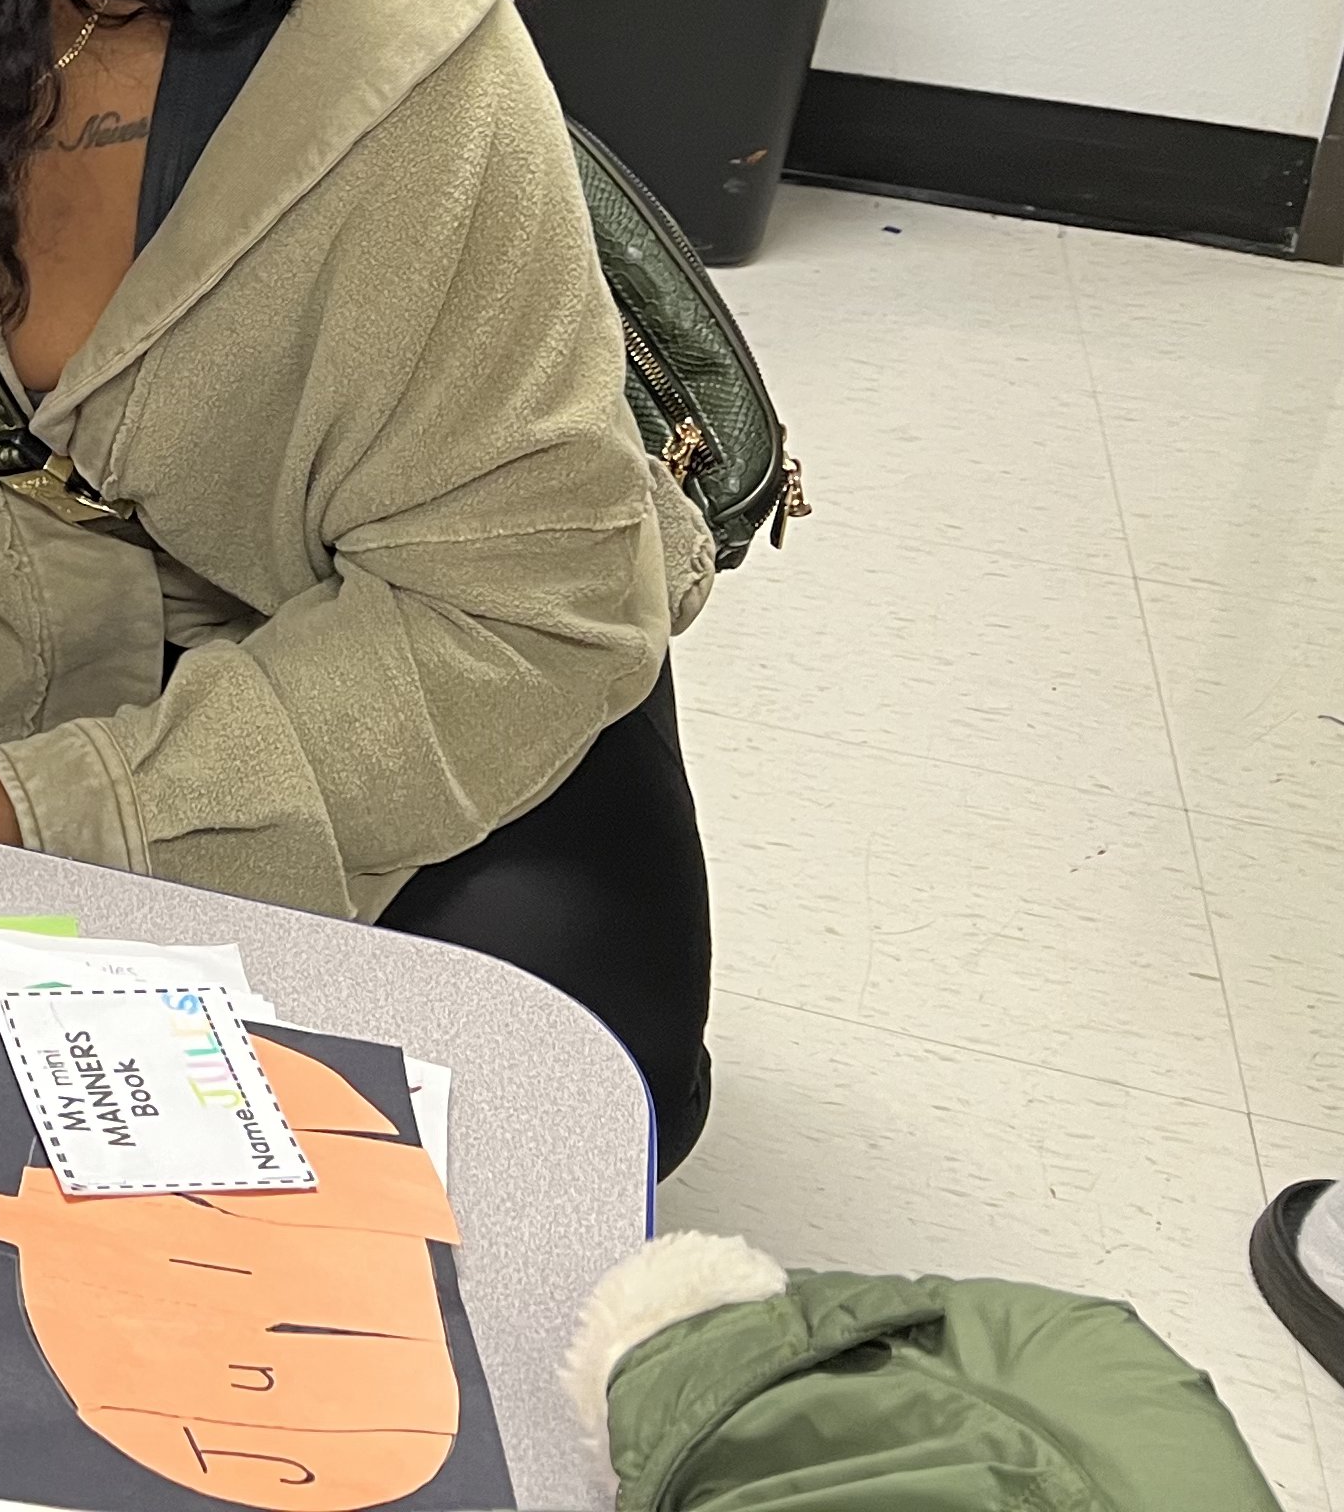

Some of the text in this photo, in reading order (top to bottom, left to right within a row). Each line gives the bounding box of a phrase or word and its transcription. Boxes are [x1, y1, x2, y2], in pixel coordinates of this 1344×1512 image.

[37, 1049, 73, 1087] mini
[64, 1029, 137, 1148] MANNERS
[235, 1108, 281, 1170] Name
